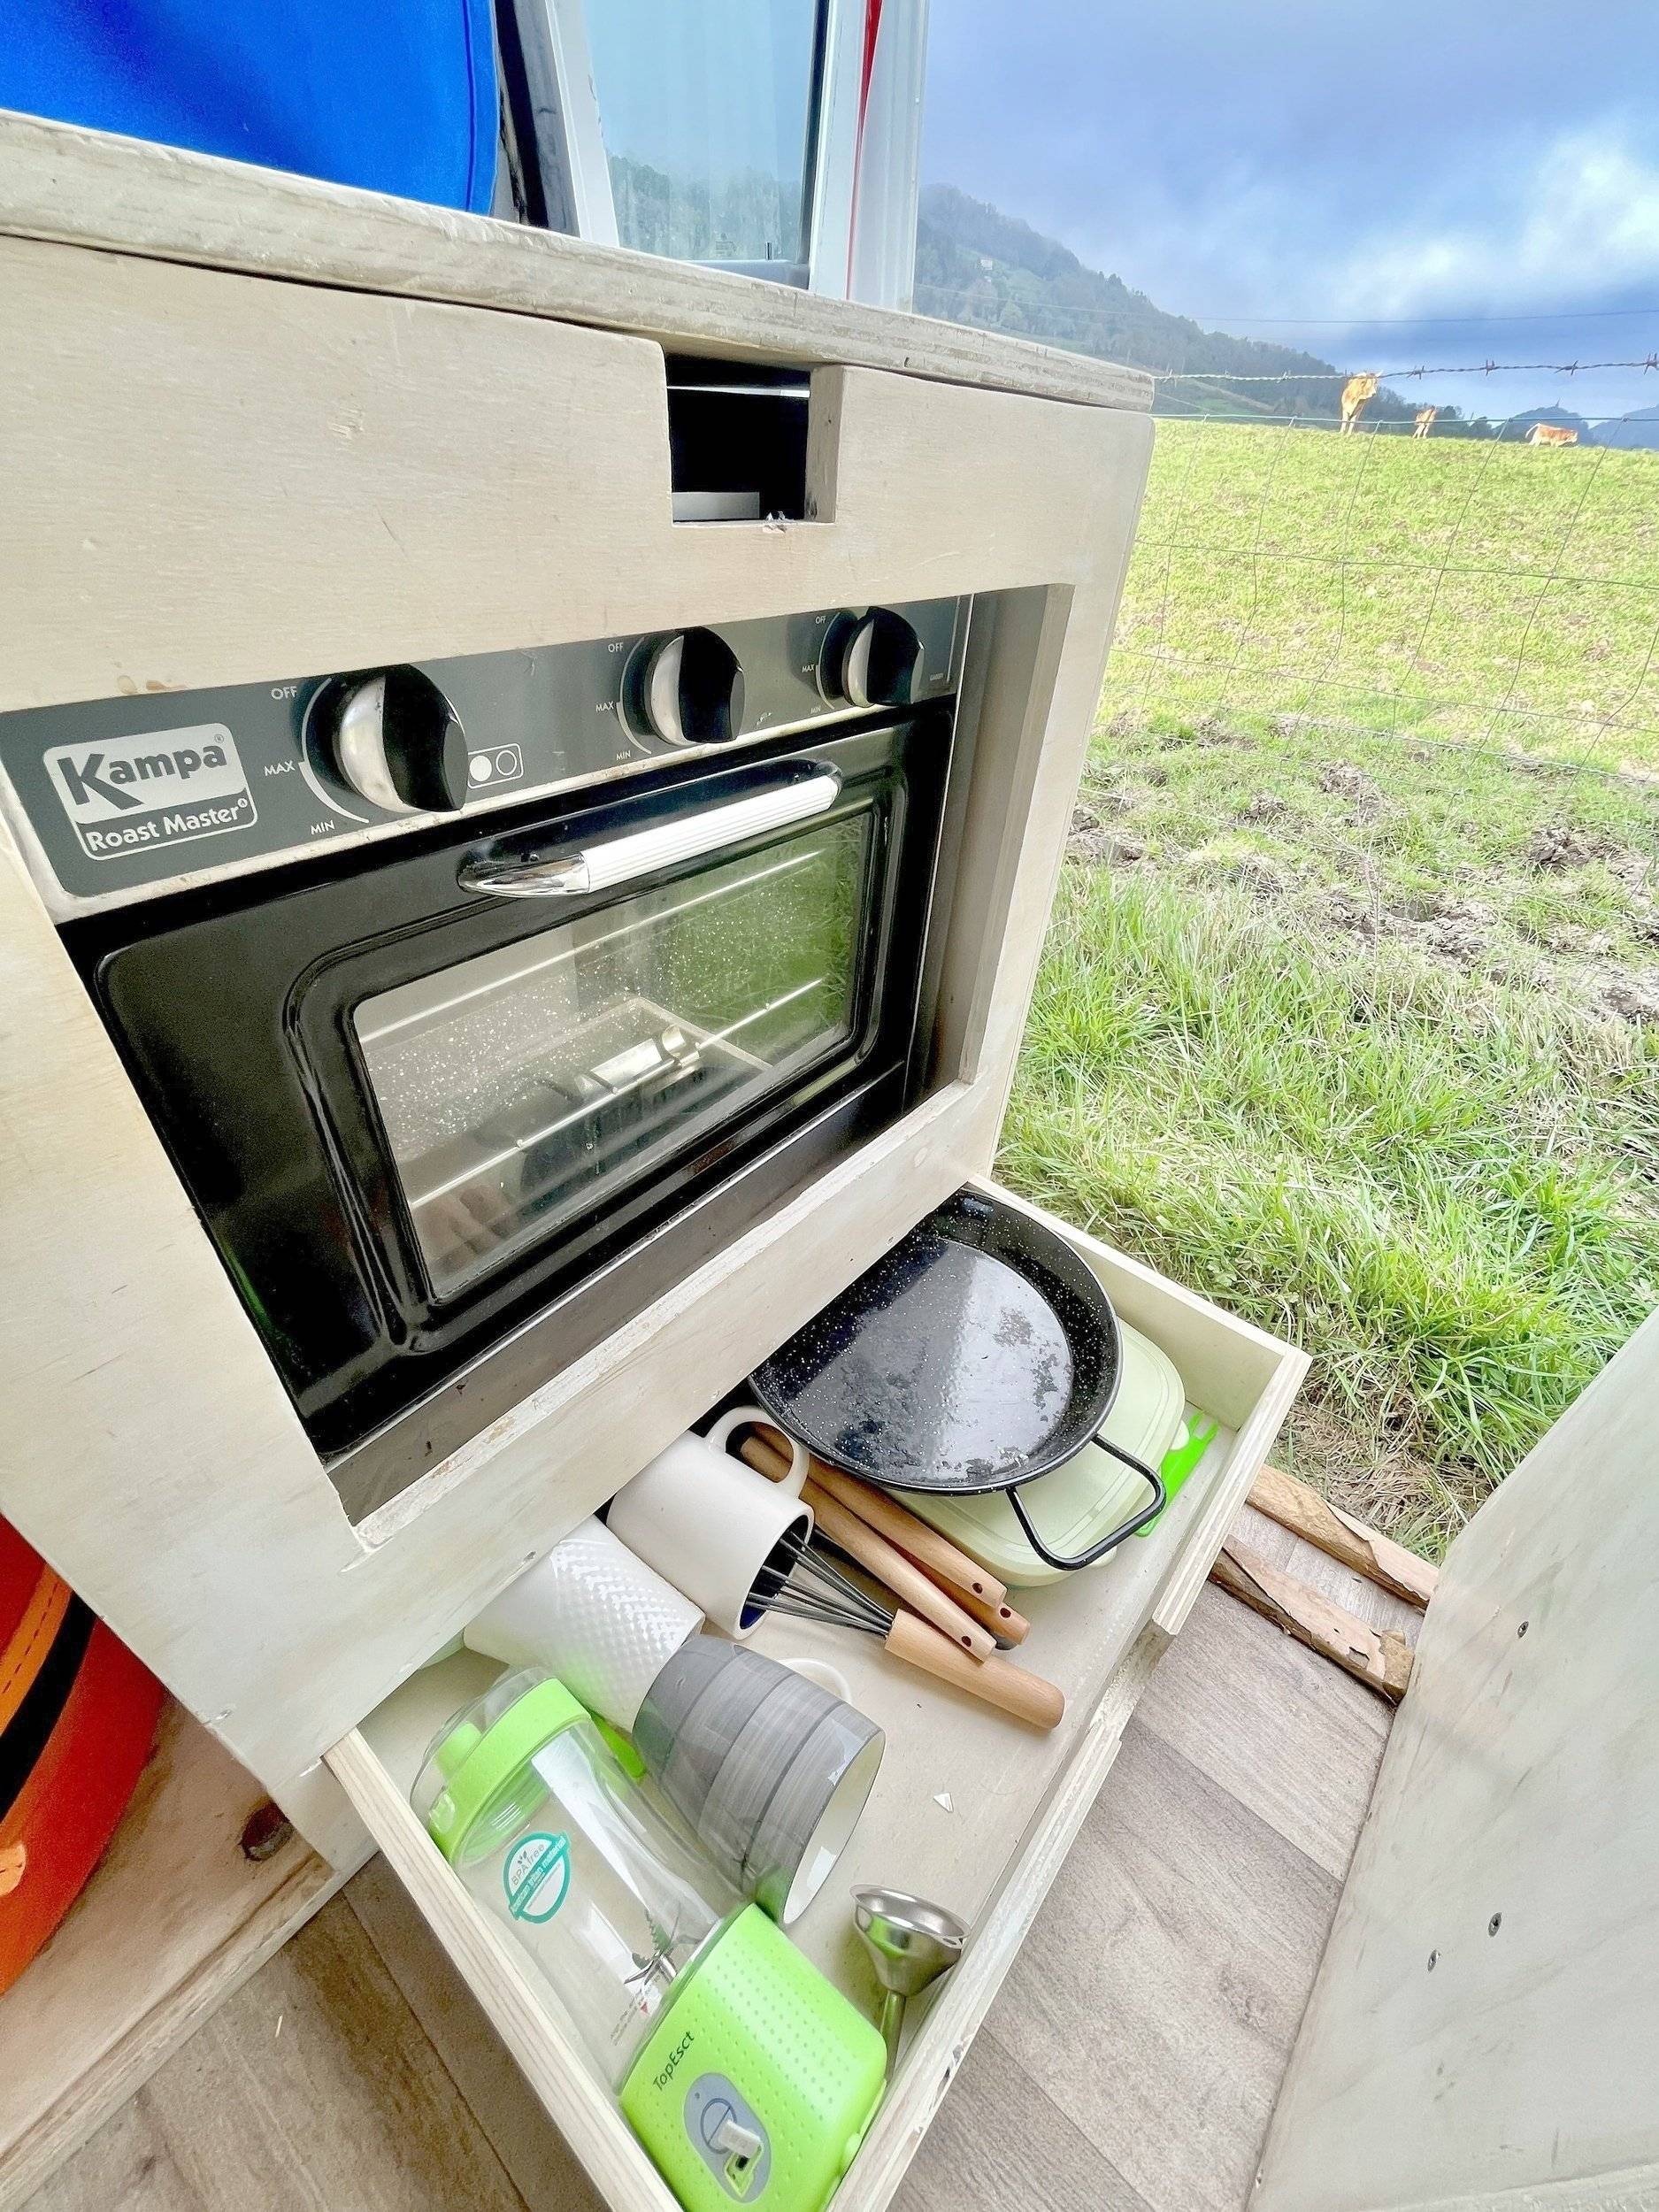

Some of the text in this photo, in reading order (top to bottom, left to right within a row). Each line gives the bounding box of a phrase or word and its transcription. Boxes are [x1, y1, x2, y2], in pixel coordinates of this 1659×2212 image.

[816, 615, 826, 625] OFF
[608, 642, 624, 653] OFF
[802, 664, 815, 673] MAX
[271, 686, 297, 700] OFF
[595, 700, 615, 712] MAX
[616, 749, 632, 761] MIN
[264, 760, 296, 776] MAX
[57, 745, 227, 810] Kampa
[86, 804, 240, 851] Roast Master
[311, 819, 335, 835] MIN
[653, 2031, 695, 2091] TopEsct
